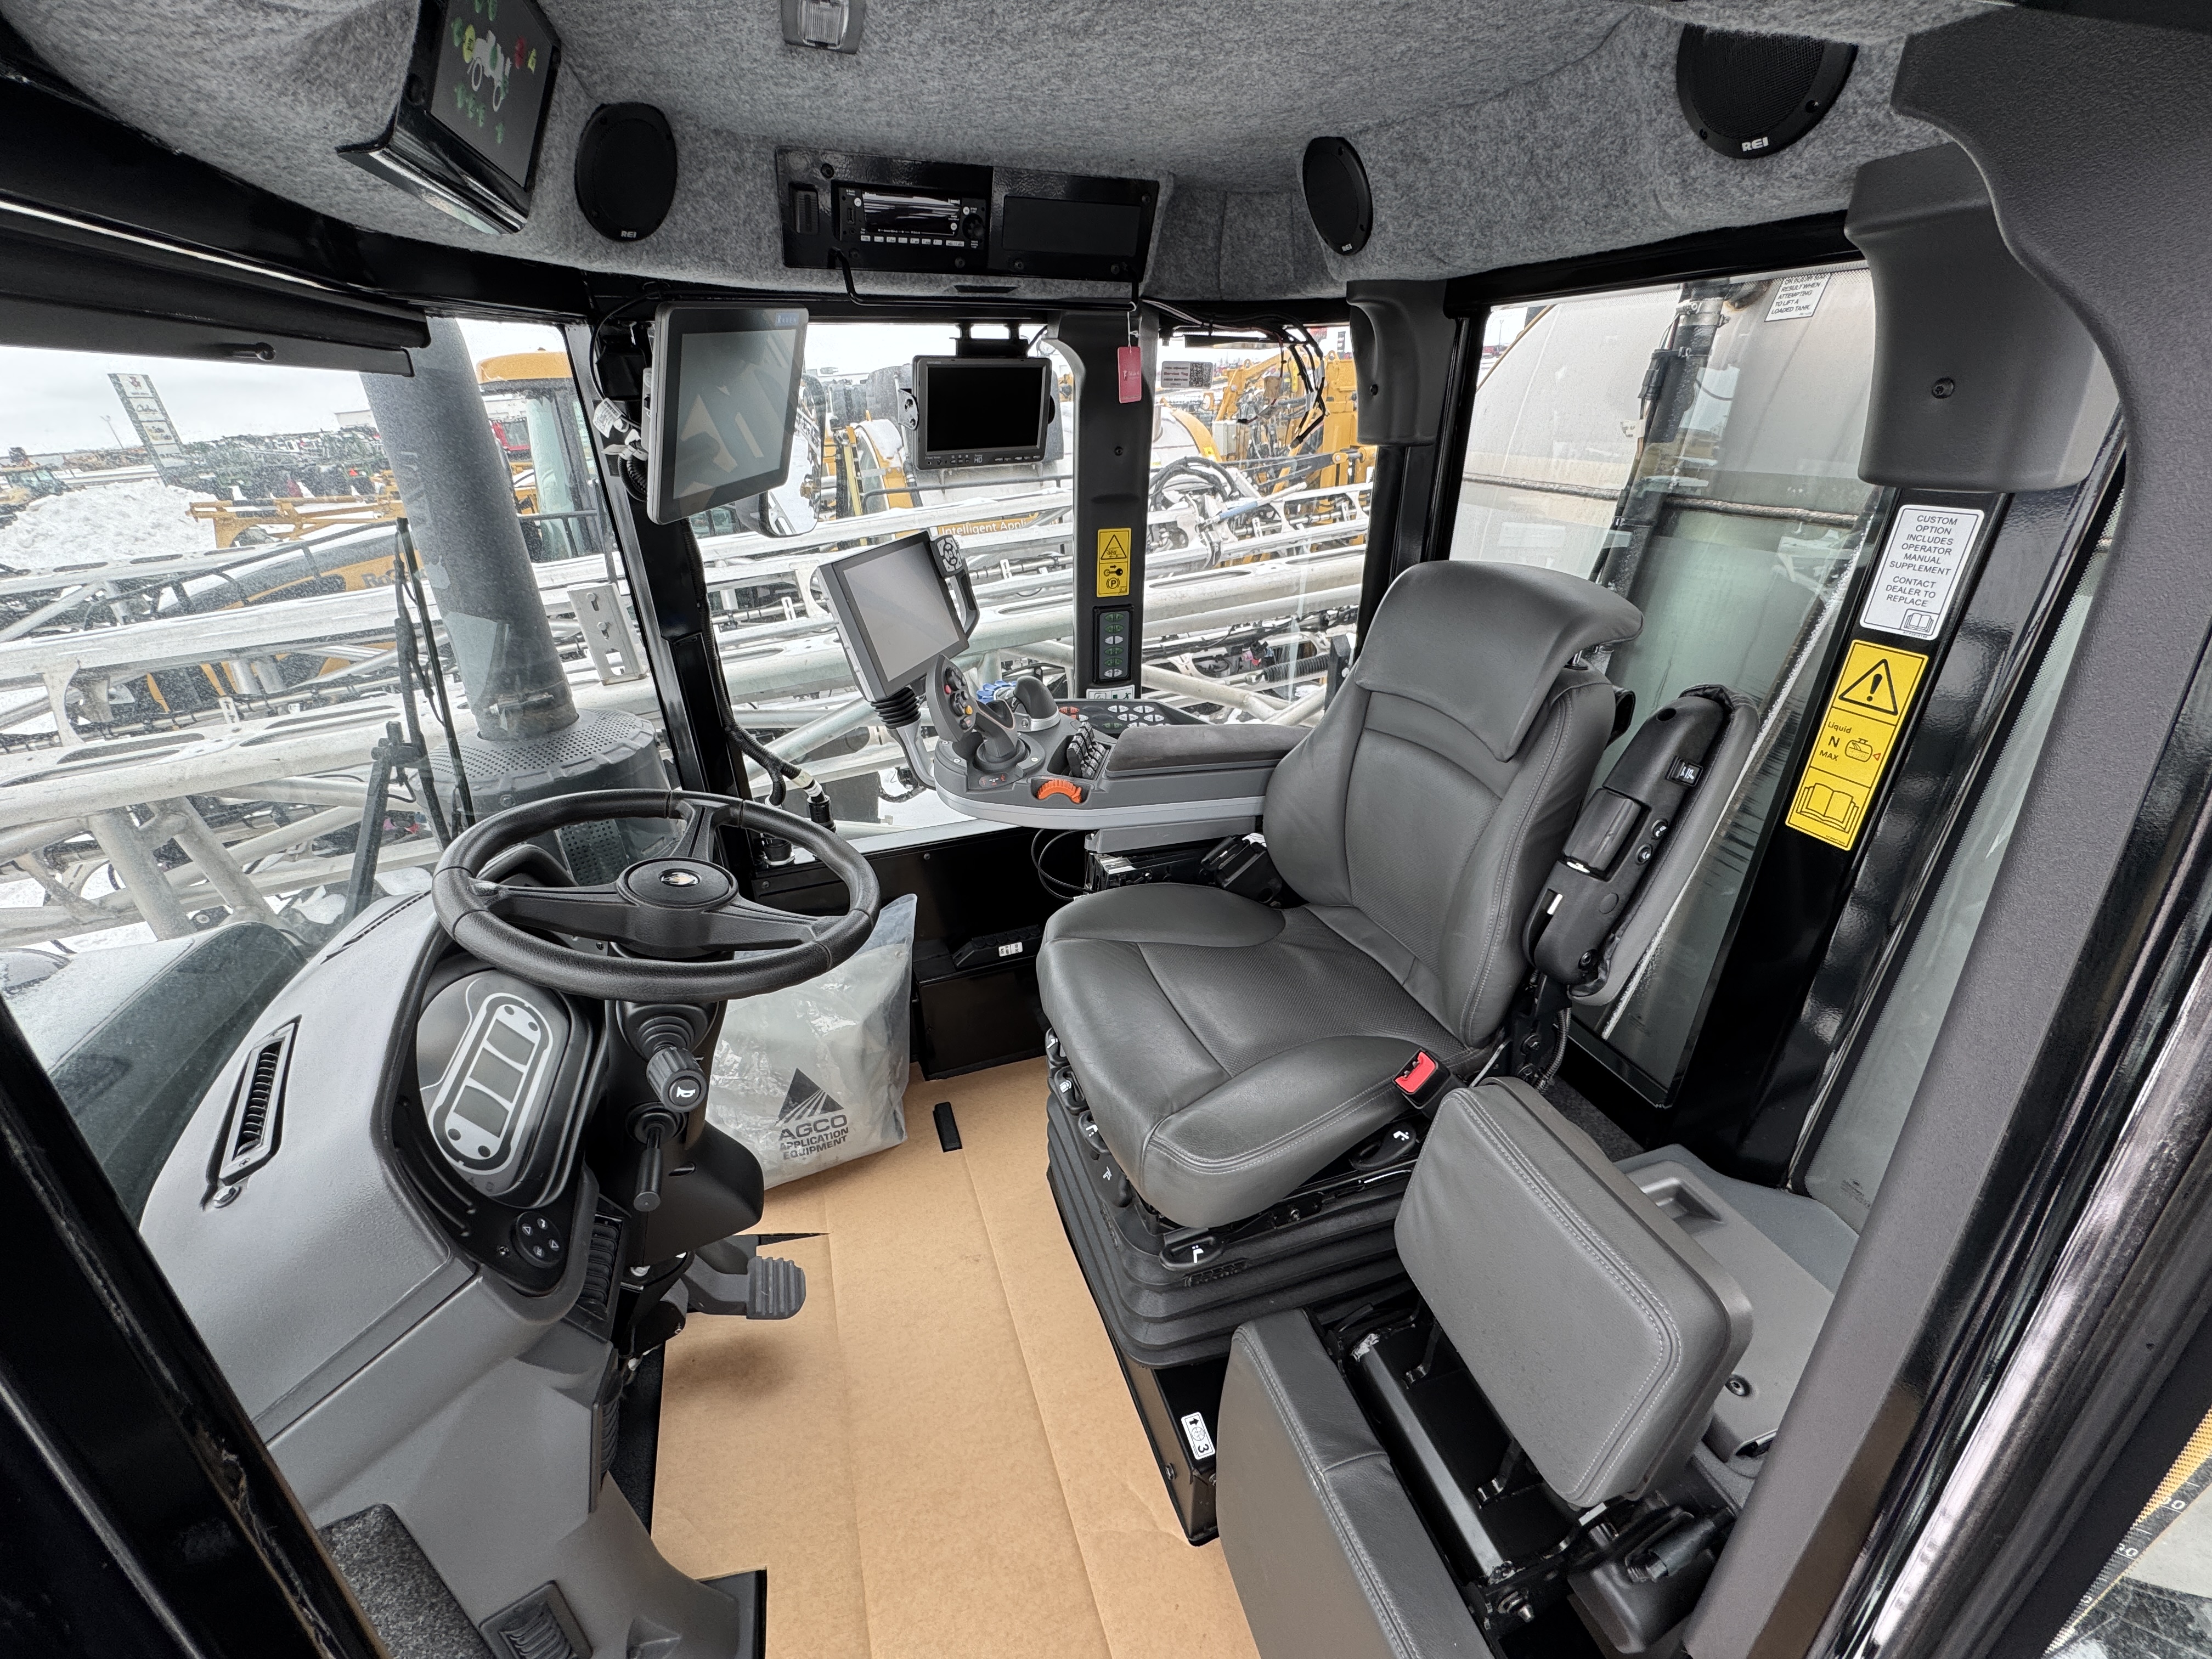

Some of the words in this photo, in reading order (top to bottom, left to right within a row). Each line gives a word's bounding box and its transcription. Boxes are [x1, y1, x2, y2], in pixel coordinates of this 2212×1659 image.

[1741, 136, 1769, 153] REI
[1341, 244, 1352, 252] REI
[1778, 290, 1813, 299] ATTEMPTING
[1917, 515, 1958, 526] CUSTOM
[941, 522, 997, 536] Intelligent
[1916, 525, 1952, 535] OPTION
[1906, 534, 1954, 545] INCLUDES
[1901, 543, 1952, 555] OPERATOR
[1904, 553, 1942, 564] MANUAL
[1889, 561, 1951, 575] SUPPLEMENT
[1893, 576, 1936, 589] CONTACT
[1886, 584, 1921, 596] DEALER
[1924, 590, 1936, 599] TO
[1887, 594, 1928, 607] REPLACE
[1827, 721, 1852, 733] Liquid
[1827, 735, 1841, 748] N
[1819, 750, 1839, 761] MAX
[779, 1114, 848, 1141] AGCO
[780, 1127, 849, 1151] APPLICATION
[783, 1135, 848, 1160] EQUIPMENT
[1198, 1443, 1210, 1453] 3
